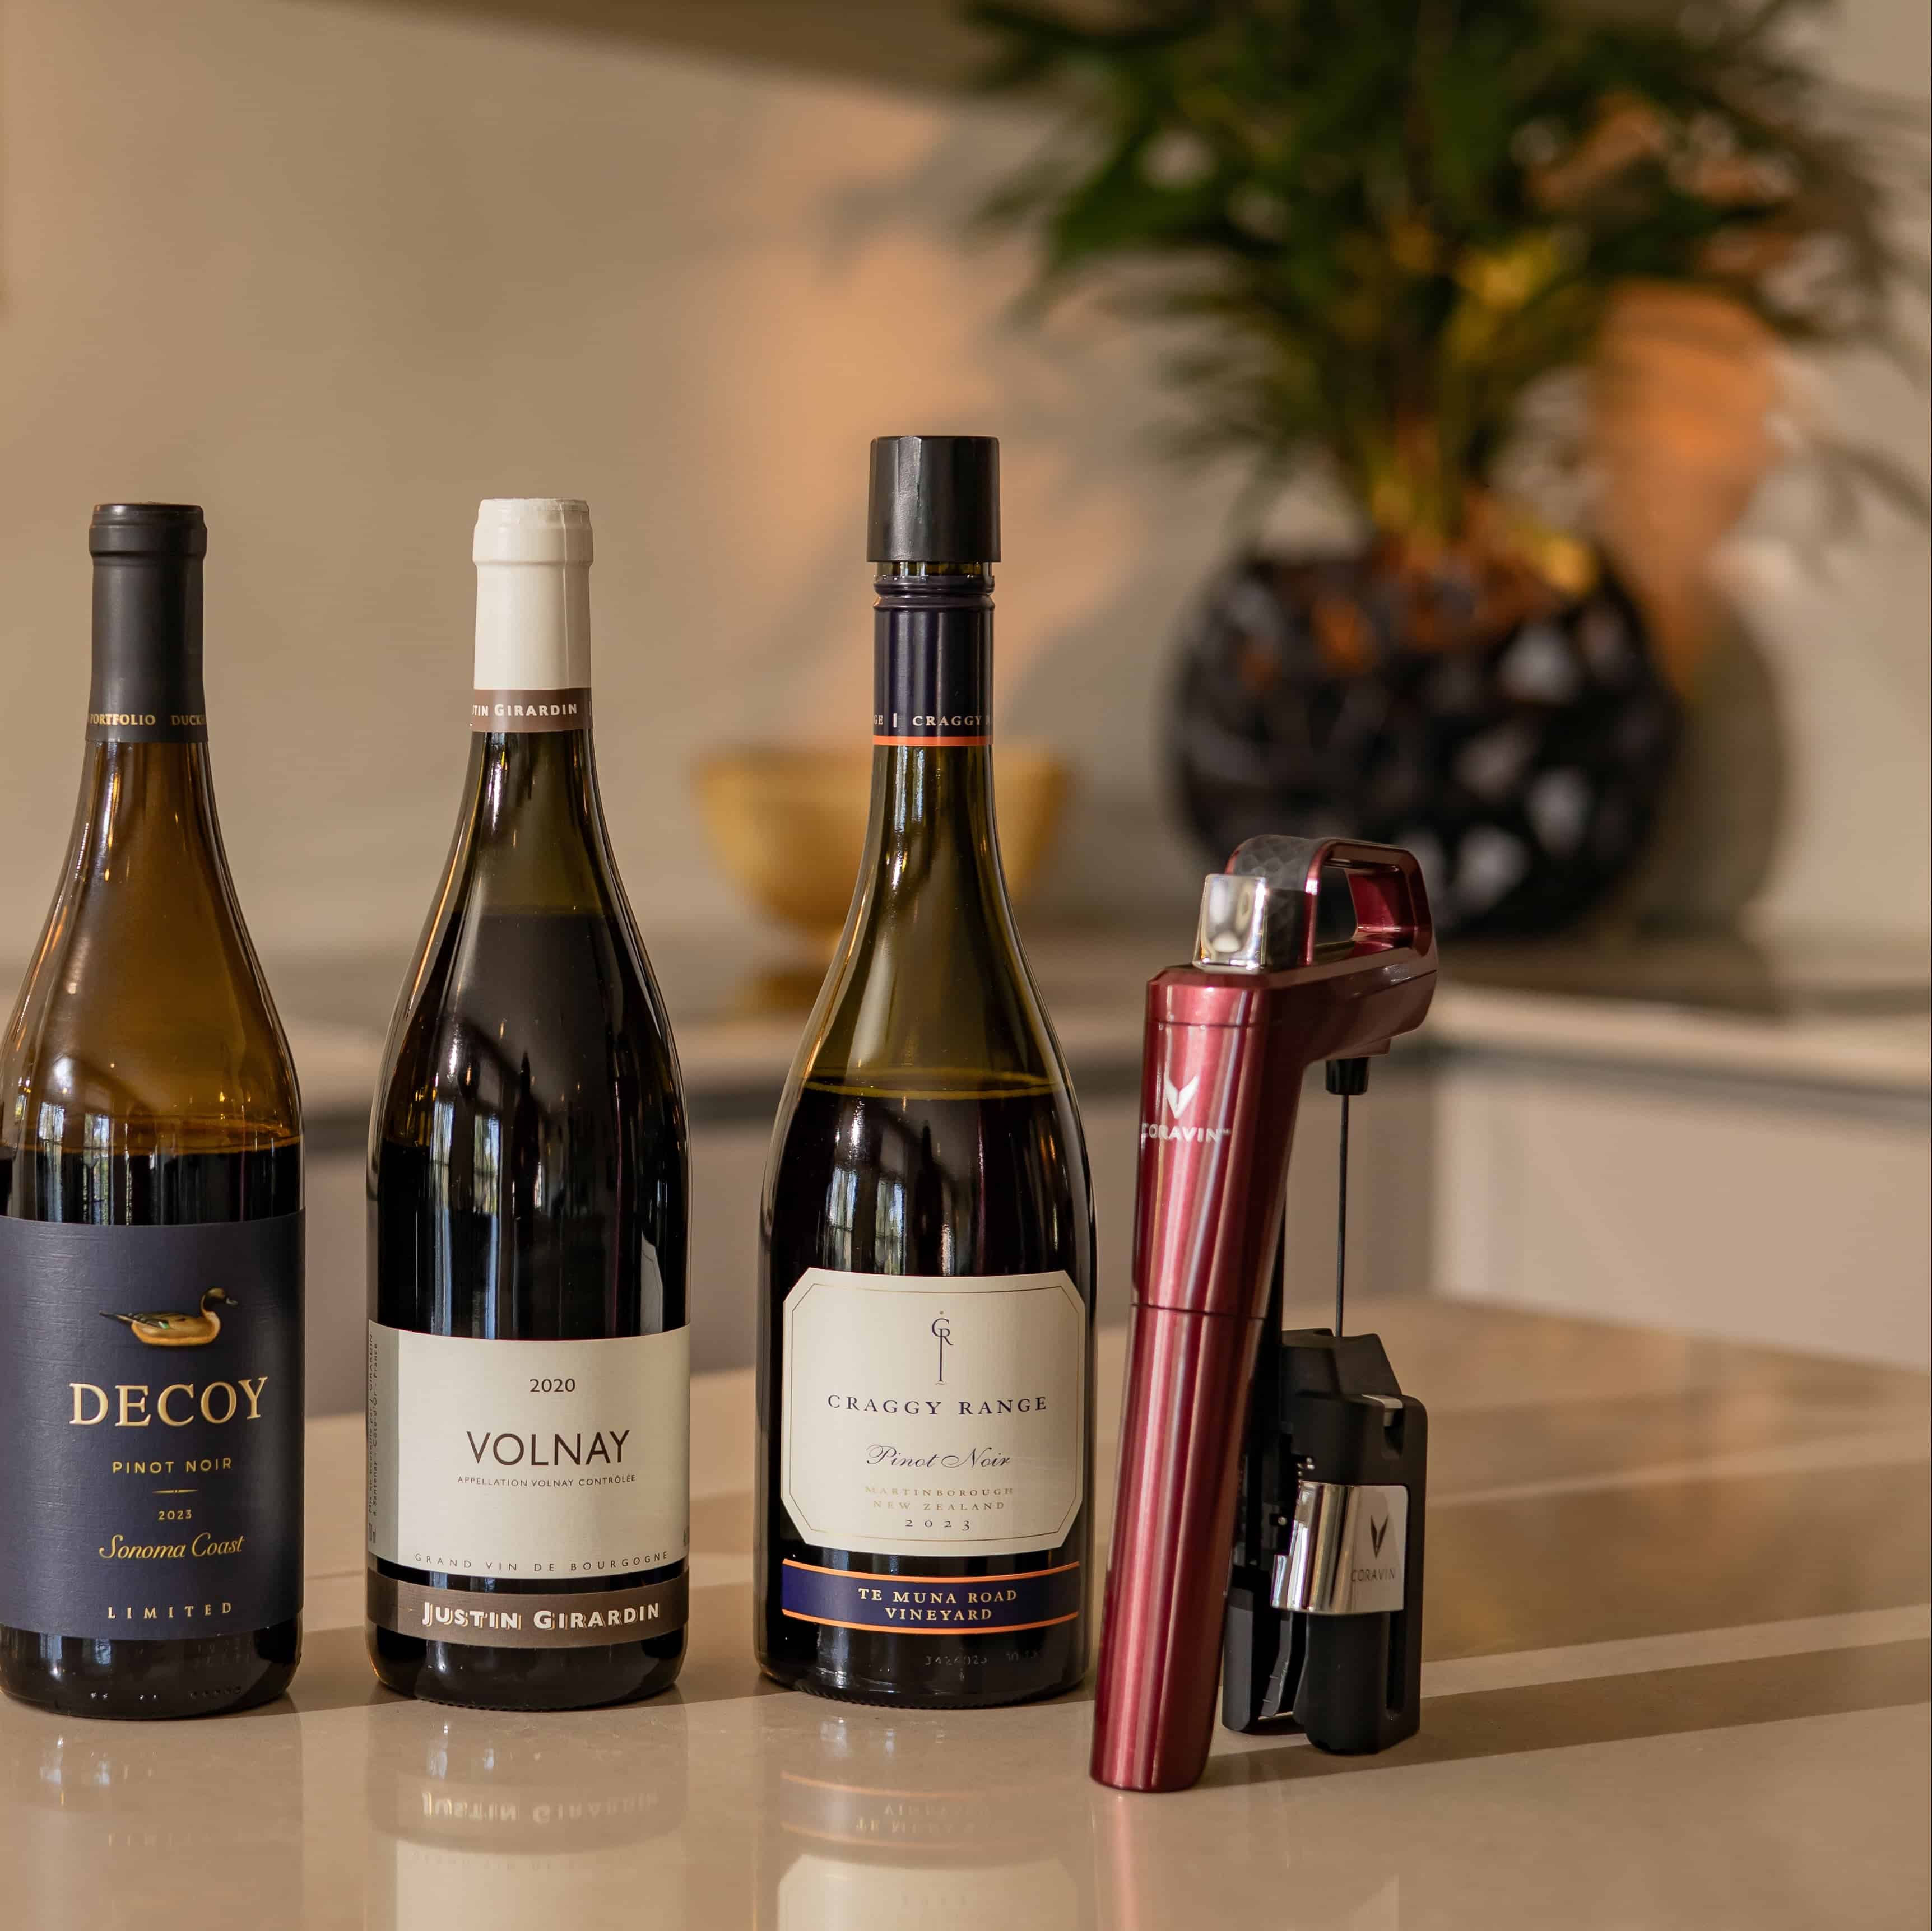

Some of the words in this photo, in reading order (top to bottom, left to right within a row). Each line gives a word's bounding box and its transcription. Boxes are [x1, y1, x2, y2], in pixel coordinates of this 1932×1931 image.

[494, 703, 577, 716] GIRARDIN
[90, 714, 156, 725] PORTFOLIO
[912, 715, 982, 726] CRAGGY
[530, 1378, 575, 1392] 2020
[69, 1376, 268, 1427] DECOY
[828, 1395, 941, 1414] CRAGGY
[959, 1397, 1047, 1414] RANGE
[466, 1429, 630, 1466] VOLNAY
[866, 1444, 938, 1468] Pinot
[941, 1447, 1011, 1468] Noir
[113, 1460, 174, 1474] PINOT
[186, 1457, 231, 1472] NOIR
[457, 1476, 528, 1487] APPELLATION
[531, 1479, 574, 1487] VOLNAY
[578, 1473, 635, 1486] CONTRÔLÉE
[865, 1486, 1014, 1497] MARTINBOROUGH
[874, 1501, 911, 1510] NEW
[923, 1502, 1005, 1511] ZEALAND
[159, 1510, 192, 1520] 2023
[905, 1519, 970, 1532] 2023
[98, 1534, 187, 1560] Sonoma
[191, 1532, 245, 1557] Coast
[415, 1553, 471, 1569] GRAND
[485, 1562, 517, 1571] VIN
[534, 1563, 555, 1572] DE
[570, 1551, 668, 1571] BOURGOGNE
[1351, 1568, 1395, 1582] CORAVIN
[858, 1588, 883, 1601] TE
[893, 1591, 956, 1604] MUNA
[968, 1590, 1017, 1603] ROAD
[108, 1602, 231, 1619] LIMITED
[422, 1602, 522, 1630] JUSTIN
[533, 1603, 661, 1631] GIRARDIN
[885, 1608, 992, 1621] VINEYARD
